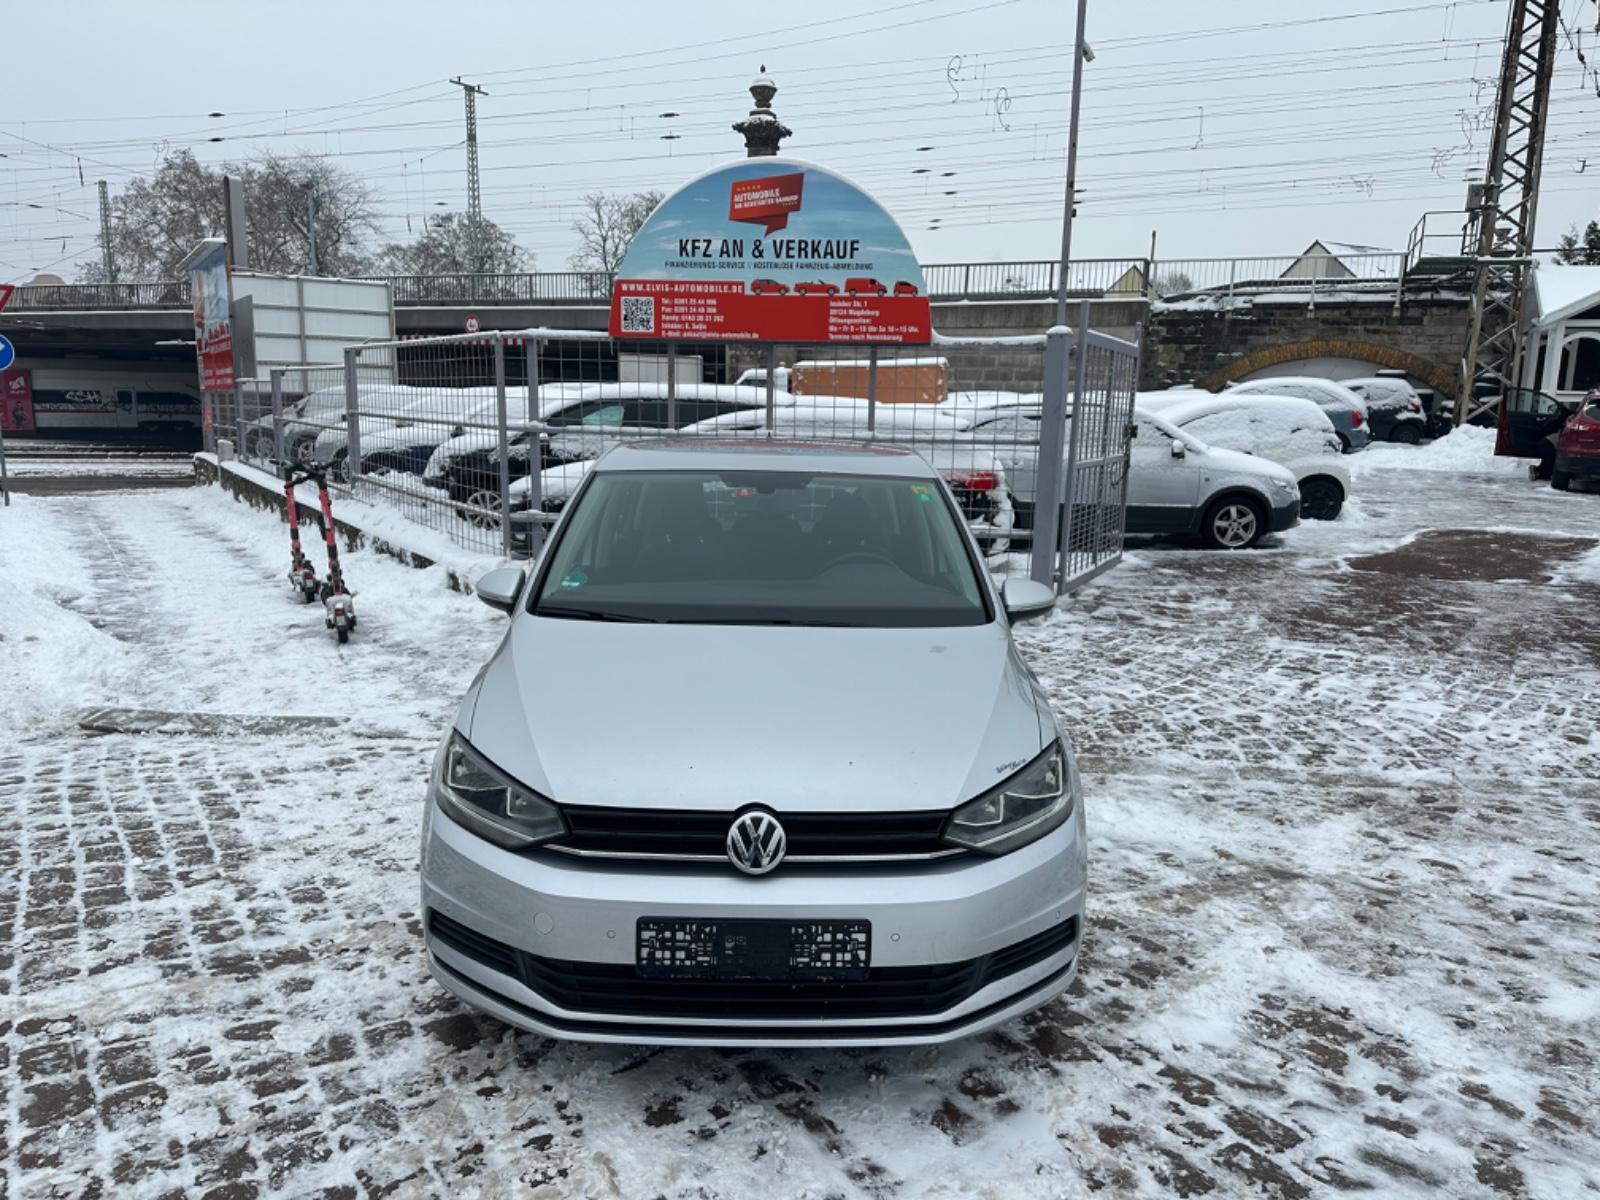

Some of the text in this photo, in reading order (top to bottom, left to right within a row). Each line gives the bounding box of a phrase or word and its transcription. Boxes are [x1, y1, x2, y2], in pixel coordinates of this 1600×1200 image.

[734, 188, 781, 202] AUTOMOBILE
[678, 239, 860, 259] KFZ AN & VERKAUF
[664, 260, 746, 269] FINANZIERUNGS-SERVICE
[753, 261, 794, 270] KOSTENLOSE
[795, 262, 874, 271] FAHRZEUG-ABMELDUNG
[620, 283, 743, 293] WWW.ELVIS-AUTOMOBILE.DE
